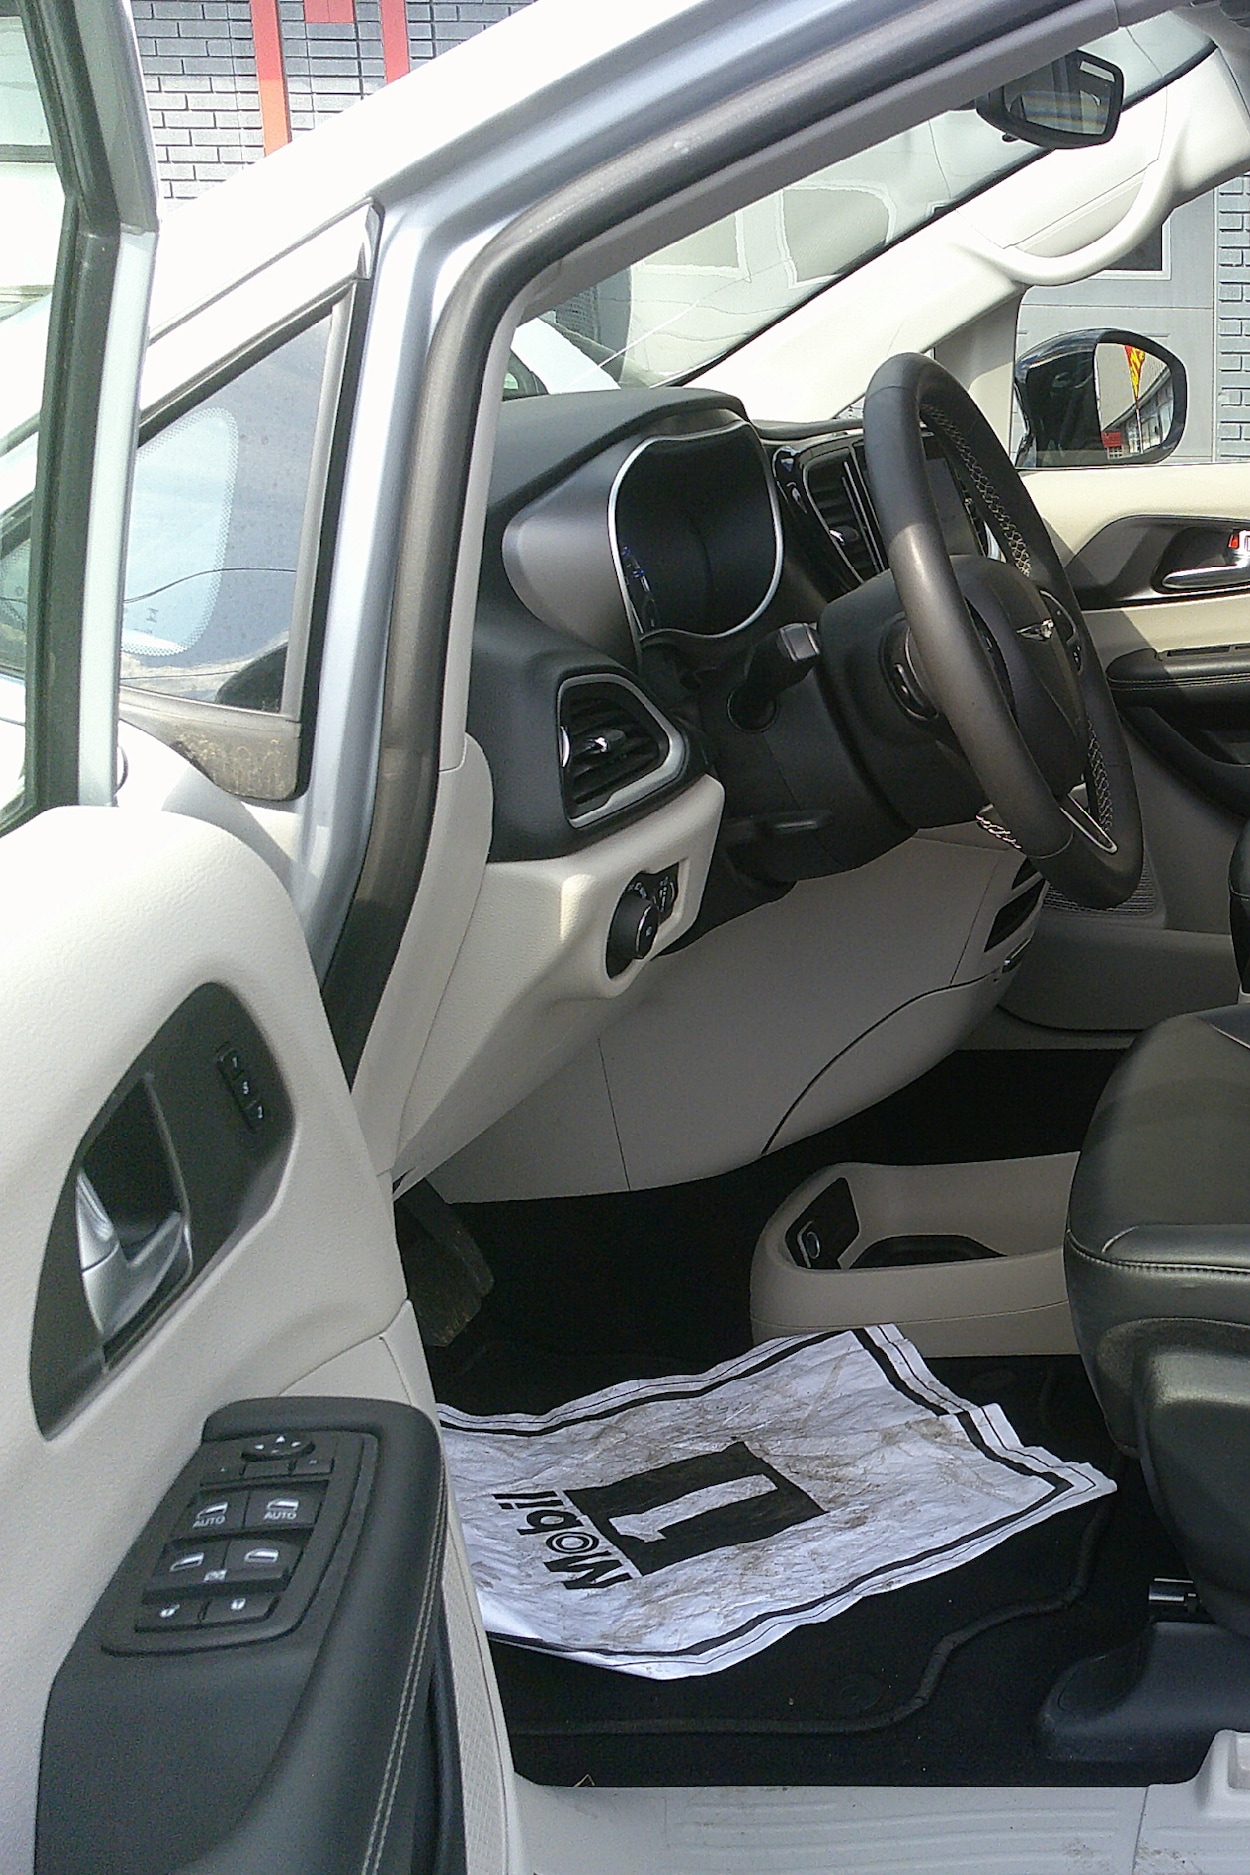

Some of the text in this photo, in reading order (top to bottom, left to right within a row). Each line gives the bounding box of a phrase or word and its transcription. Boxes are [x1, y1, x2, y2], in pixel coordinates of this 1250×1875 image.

[192, 1515, 226, 1528] AUTO
[263, 1511, 297, 1520] AUTO
[492, 1474, 779, 1590] Mobil 1
